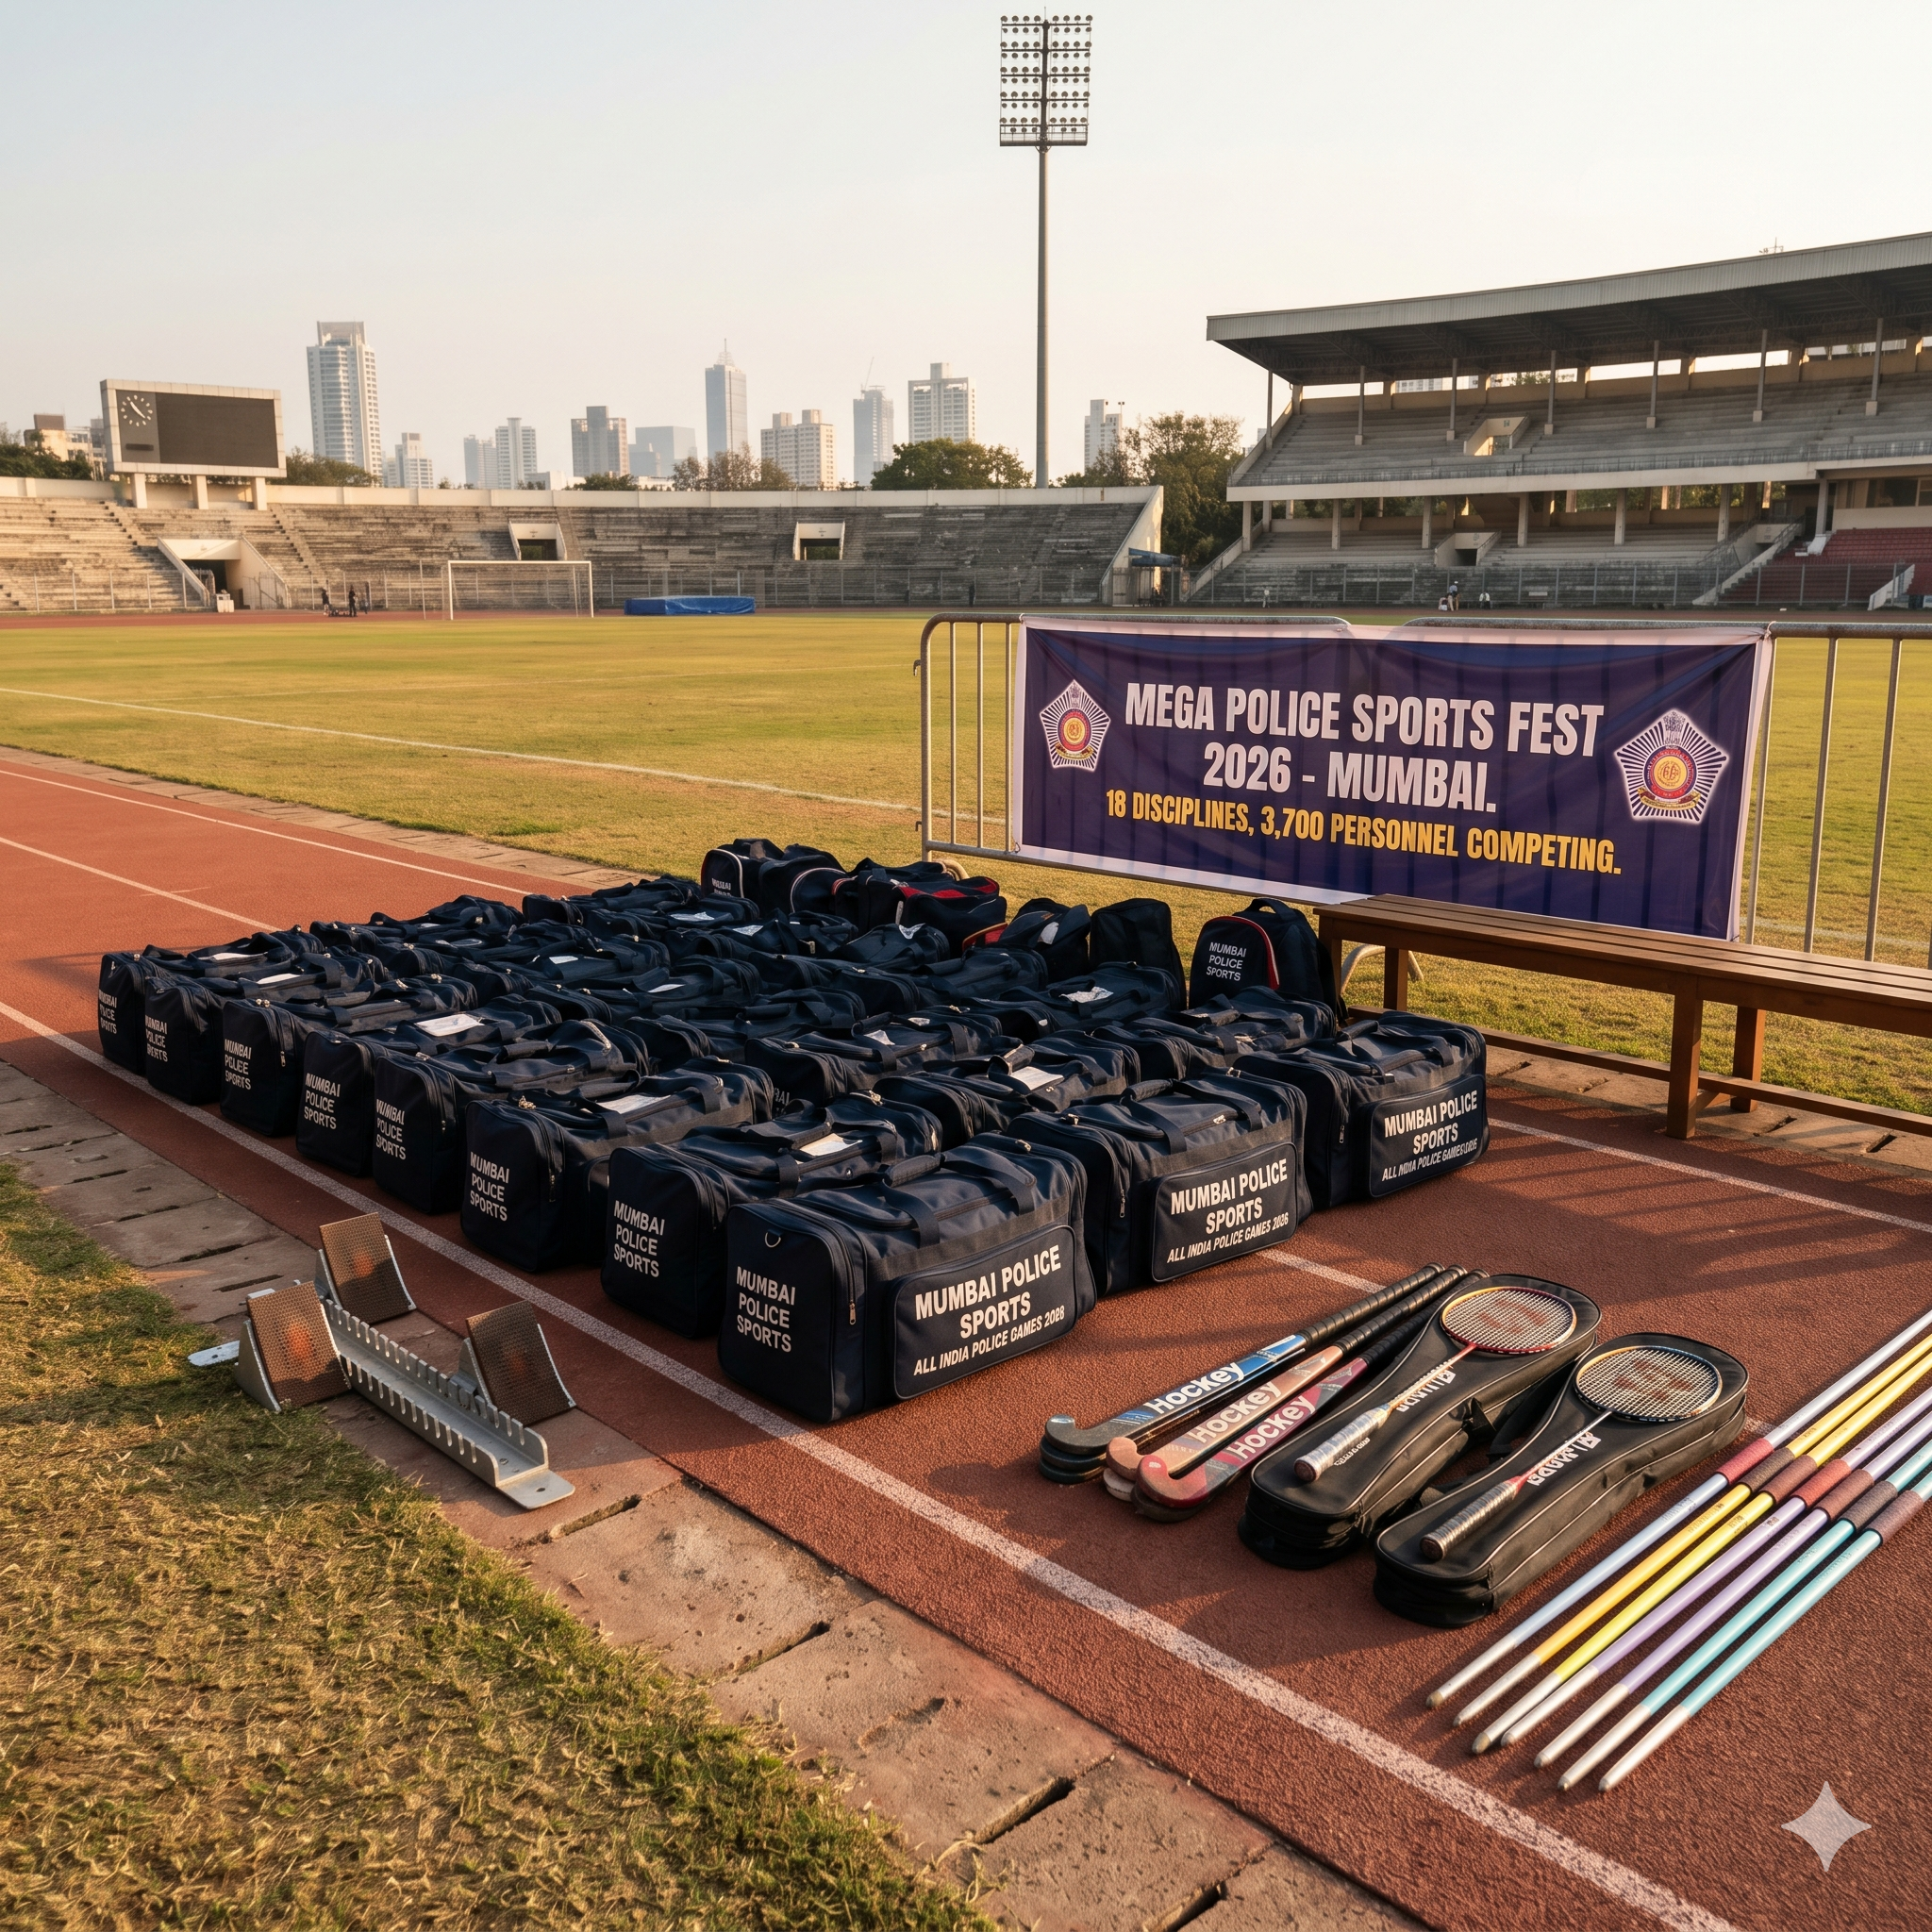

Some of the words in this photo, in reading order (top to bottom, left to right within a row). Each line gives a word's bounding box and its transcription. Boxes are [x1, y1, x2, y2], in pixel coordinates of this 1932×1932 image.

[1125, 682, 1215, 731] MEGA
[1226, 688, 1341, 740] POLICE
[1352, 693, 1495, 750] SPORTS
[1507, 701, 1605, 757] FEST
[1204, 741, 1291, 792] 2026
[1327, 751, 1496, 812] MUMBAI.
[1106, 789, 1126, 818] 18
[1132, 791, 1255, 837] DISCIPLINES,
[1260, 806, 1324, 841] 3,700
[1330, 812, 1458, 857] PERSONNEL
[1467, 827, 1622, 874] COMPETING.
[1208, 941, 1247, 958] MUMBAI
[1208, 955, 1243, 970] POLICE
[1206, 965, 1241, 981] SPORTS
[305, 1073, 341, 1098] MUMBAI
[305, 1090, 335, 1113] POLICE
[304, 1106, 337, 1130] SPORTS
[375, 1098, 406, 1125] MUMBAI
[376, 1117, 403, 1142] POLICE
[1384, 1105, 1438, 1138] MUMBAI
[1439, 1090, 1477, 1123] POLICE
[375, 1133, 407, 1160] SPORTS
[1412, 1122, 1458, 1155] SPORTS
[470, 1151, 510, 1184] MUMBAI
[1381, 1165, 1397, 1182] ALL
[1417, 1151, 1441, 1170] POLICE
[472, 1173, 505, 1203] POLICE
[1171, 1176, 1236, 1215] MUMBAI
[1239, 1158, 1288, 1197] POLICE
[470, 1190, 508, 1222] SPORTS
[613, 1200, 665, 1236] MUMBAI
[1206, 1196, 1262, 1234] SPORTS
[615, 1224, 658, 1257] POLICE
[1166, 1246, 1186, 1264] ALL
[1187, 1239, 1211, 1258] INDIA
[1213, 1228, 1244, 1251] POLICE
[1244, 1219, 1272, 1241] GAMES
[613, 1242, 659, 1278] SPORTS
[736, 1266, 796, 1306] MUMBAI
[915, 1272, 997, 1321] MUMBAI
[1001, 1244, 1061, 1293] POLICE
[739, 1292, 791, 1328] POLICE
[959, 1291, 1031, 1339] SPORTS
[737, 1314, 791, 1353] SPORTS
[913, 1356, 937, 1376] ALL
[939, 1345, 969, 1370] INDIA
[971, 1329, 1008, 1358] POLICE
[1010, 1315, 1042, 1343] GAMES
[1143, 1361, 1245, 1415] Hockey
[1188, 1380, 1282, 1444] Hockey
[1226, 1395, 1316, 1459] Hockey
